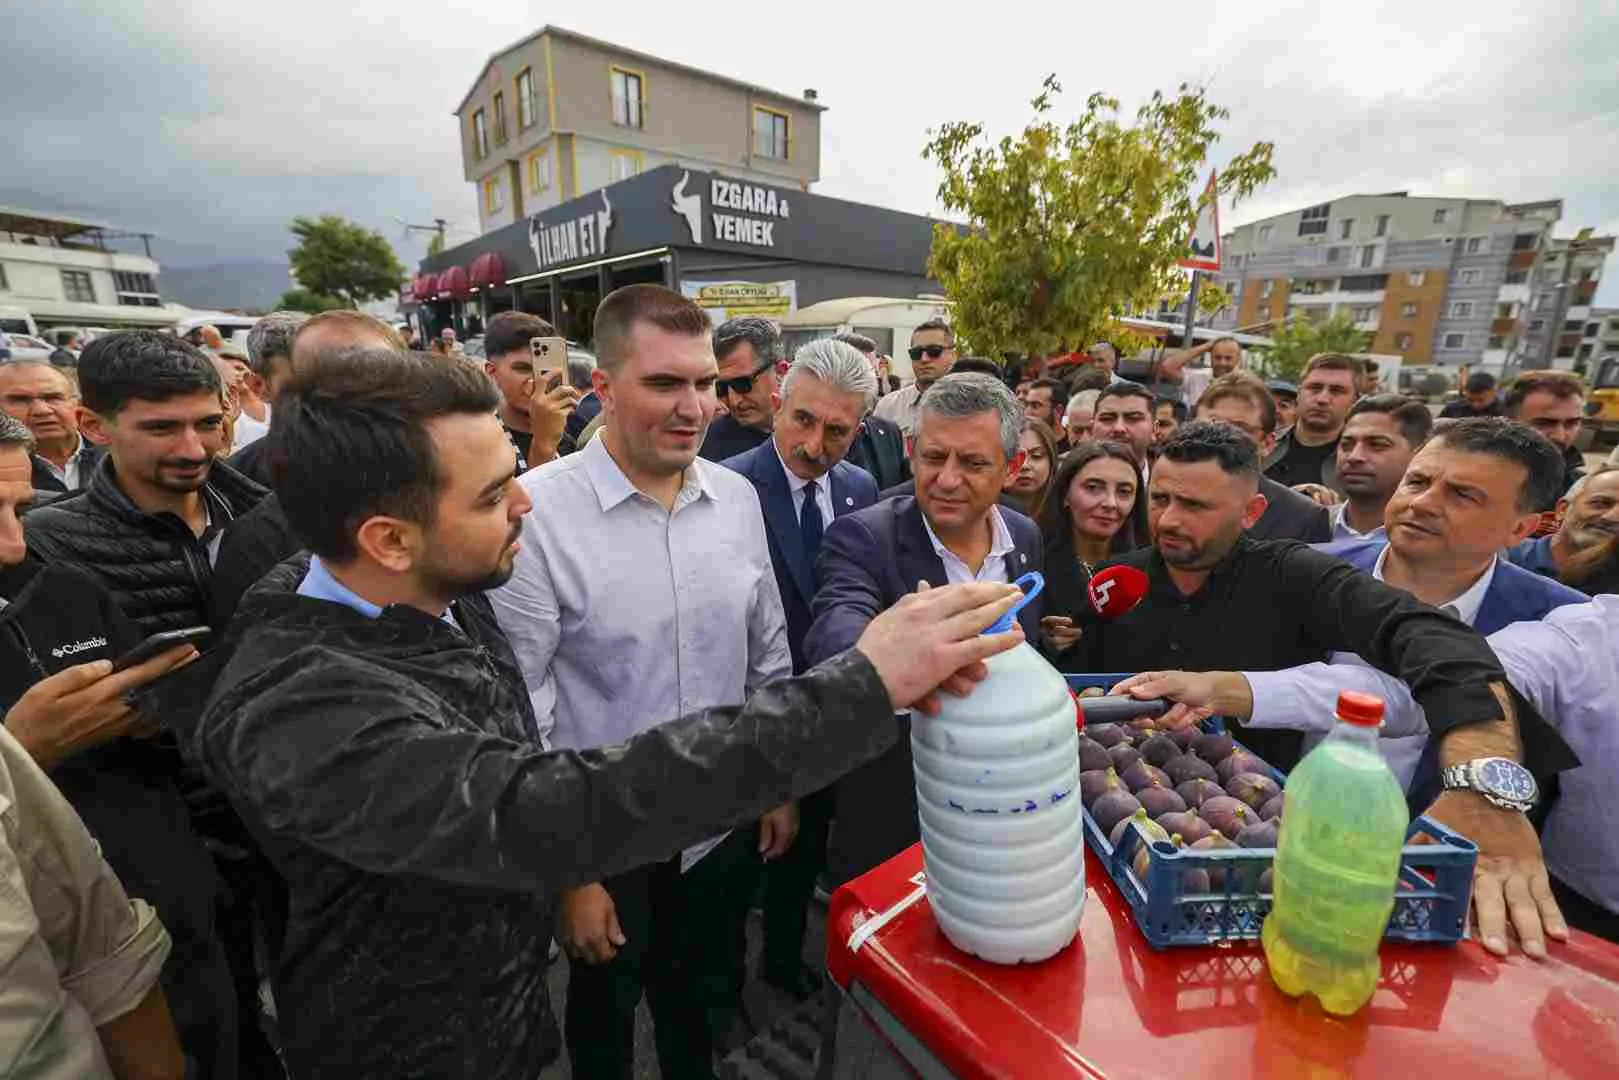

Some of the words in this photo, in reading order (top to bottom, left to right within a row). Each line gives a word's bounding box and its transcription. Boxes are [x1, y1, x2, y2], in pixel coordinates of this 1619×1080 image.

[712, 179, 777, 216] IZGARA
[580, 213, 595, 256] ET
[713, 213, 774, 247] YEMEK
[62, 636, 107, 655] Columbia
